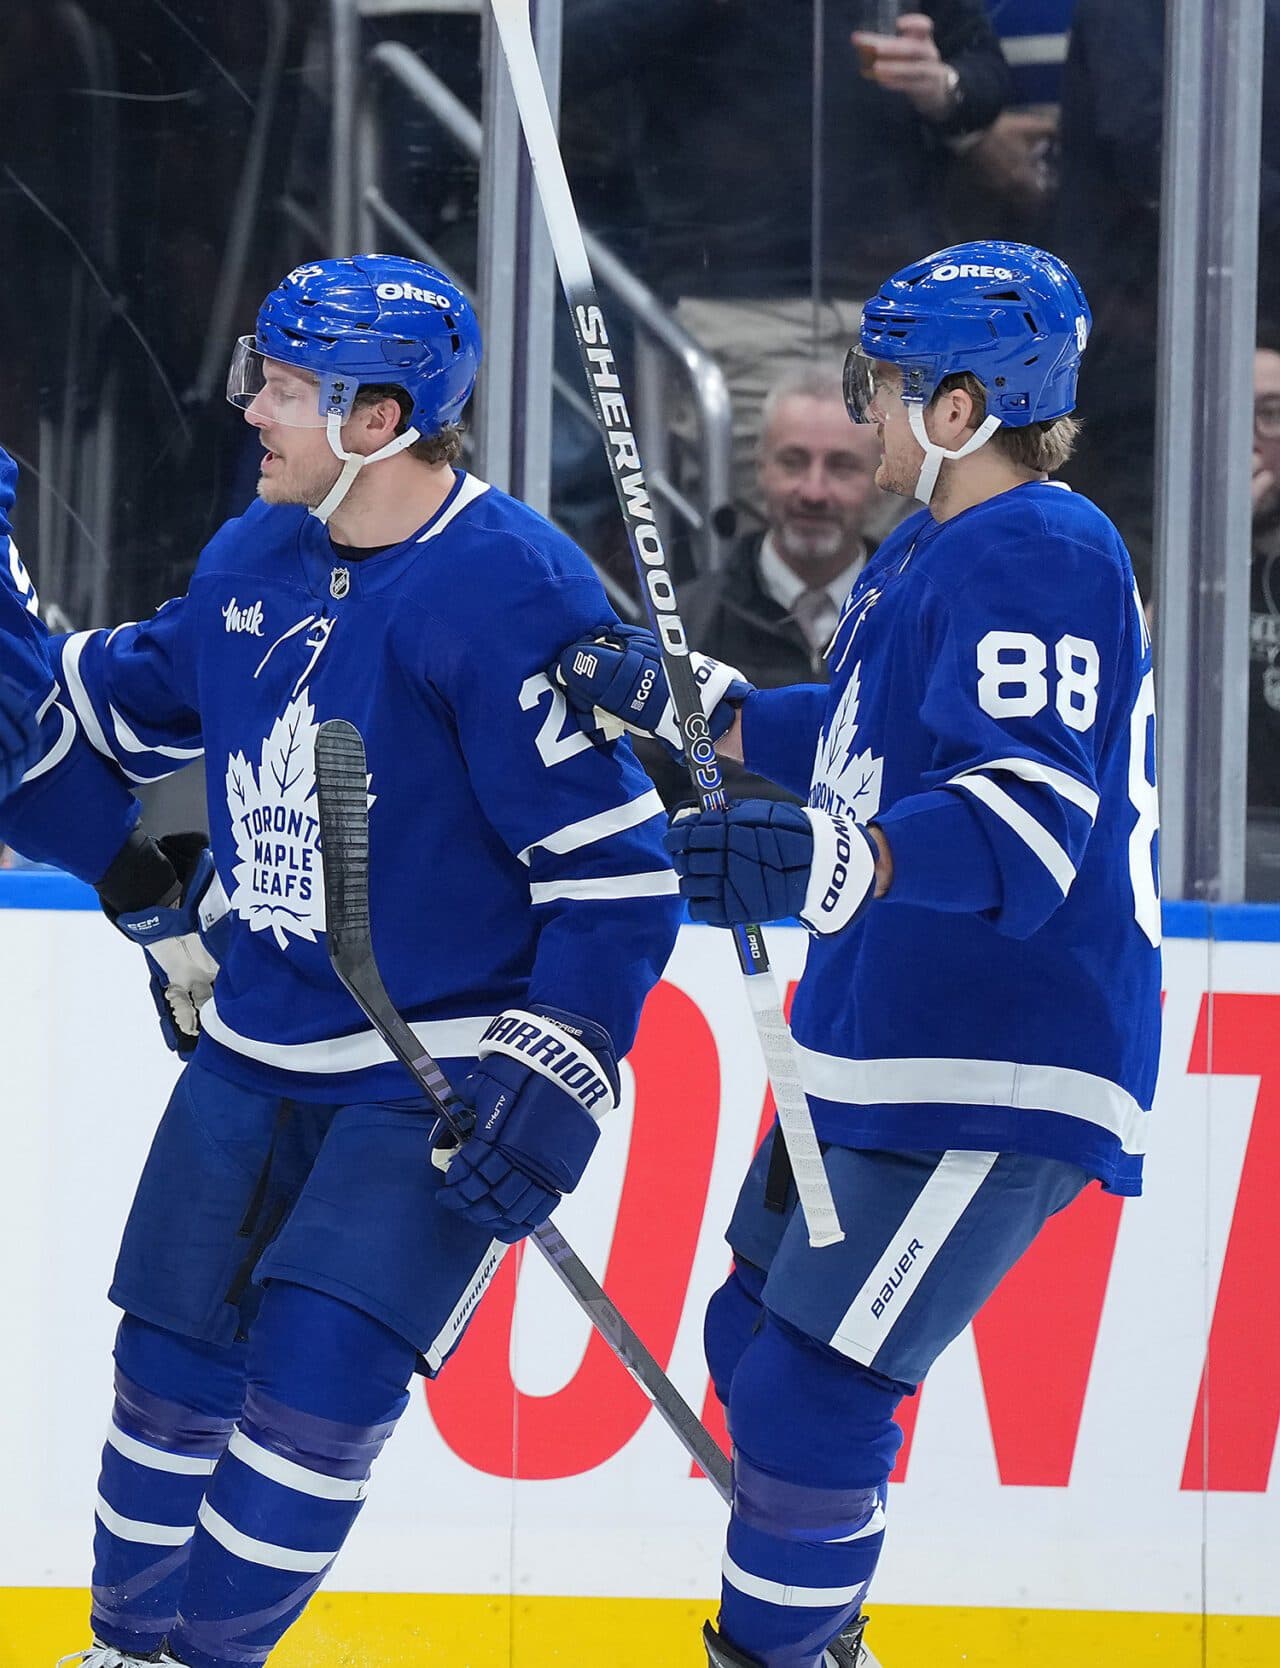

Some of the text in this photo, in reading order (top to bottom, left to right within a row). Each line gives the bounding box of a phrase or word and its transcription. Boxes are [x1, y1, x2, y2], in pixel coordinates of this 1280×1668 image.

[932, 264, 1013, 282] OREO
[376, 283, 452, 309] OREO
[575, 304, 689, 657] SHERWOOD
[222, 597, 264, 637] Milk
[976, 630, 1100, 733] 88
[254, 839, 313, 872] MAPLE
[252, 867, 312, 901] LEAFS
[747, 934, 761, 959] PRO
[870, 1238, 924, 1320] BAUER
